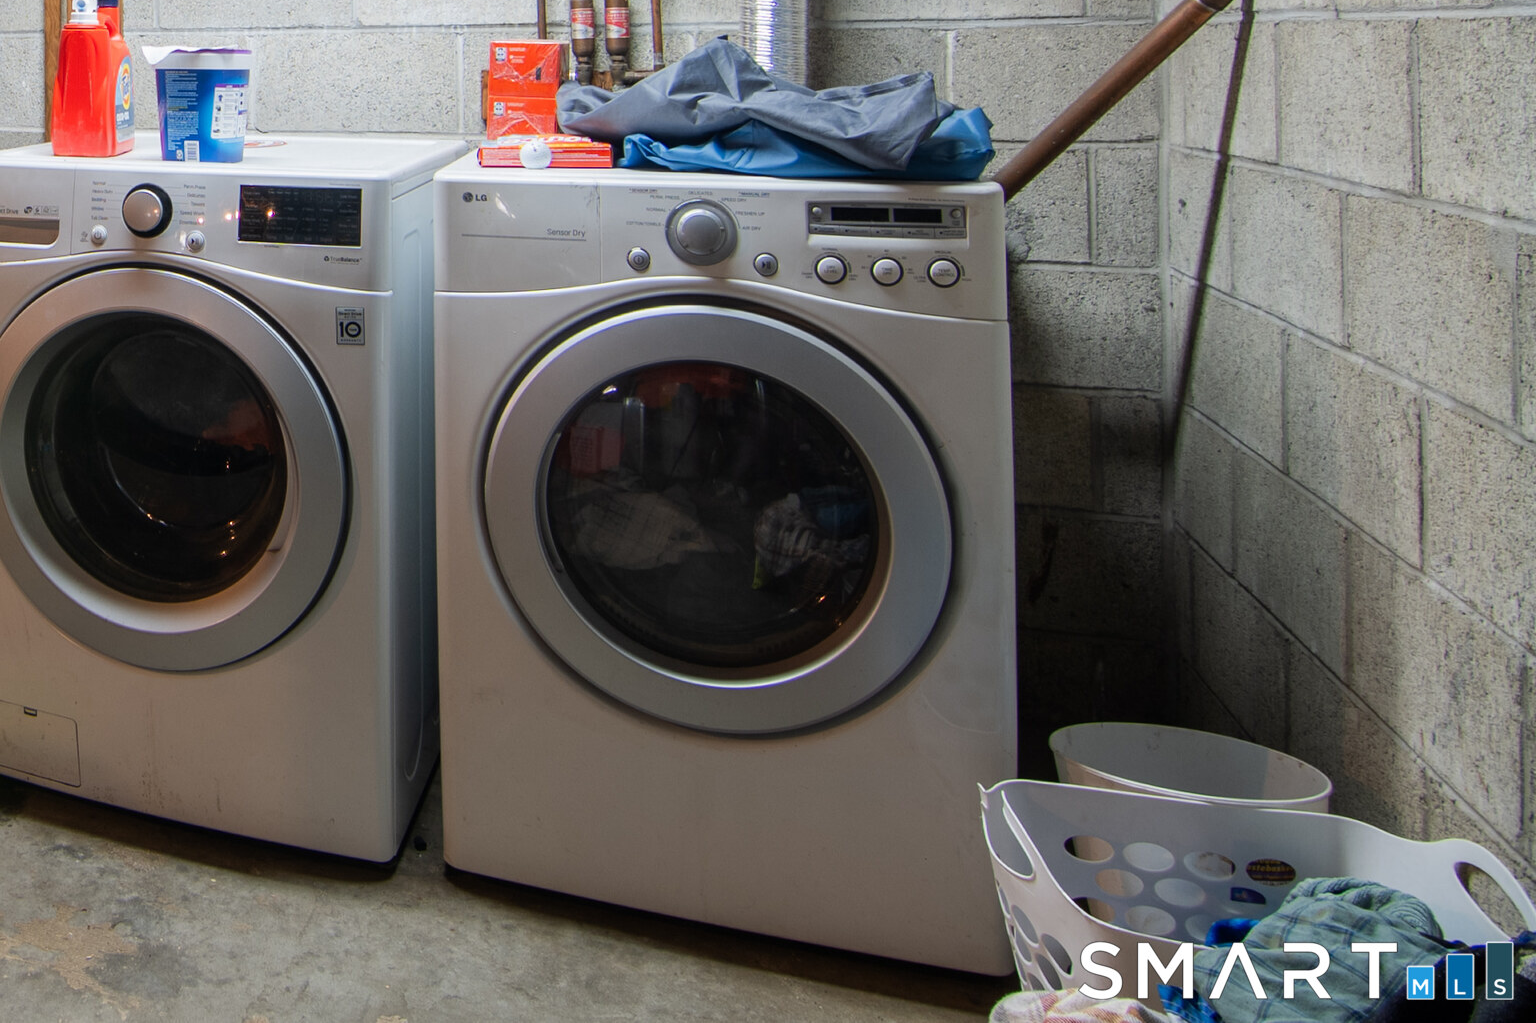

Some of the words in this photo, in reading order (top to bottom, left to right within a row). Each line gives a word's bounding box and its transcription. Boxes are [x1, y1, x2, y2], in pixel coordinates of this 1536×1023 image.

[546, 228, 571, 236] Sensor
[572, 229, 586, 238] Dry
[339, 321, 362, 338] 10
